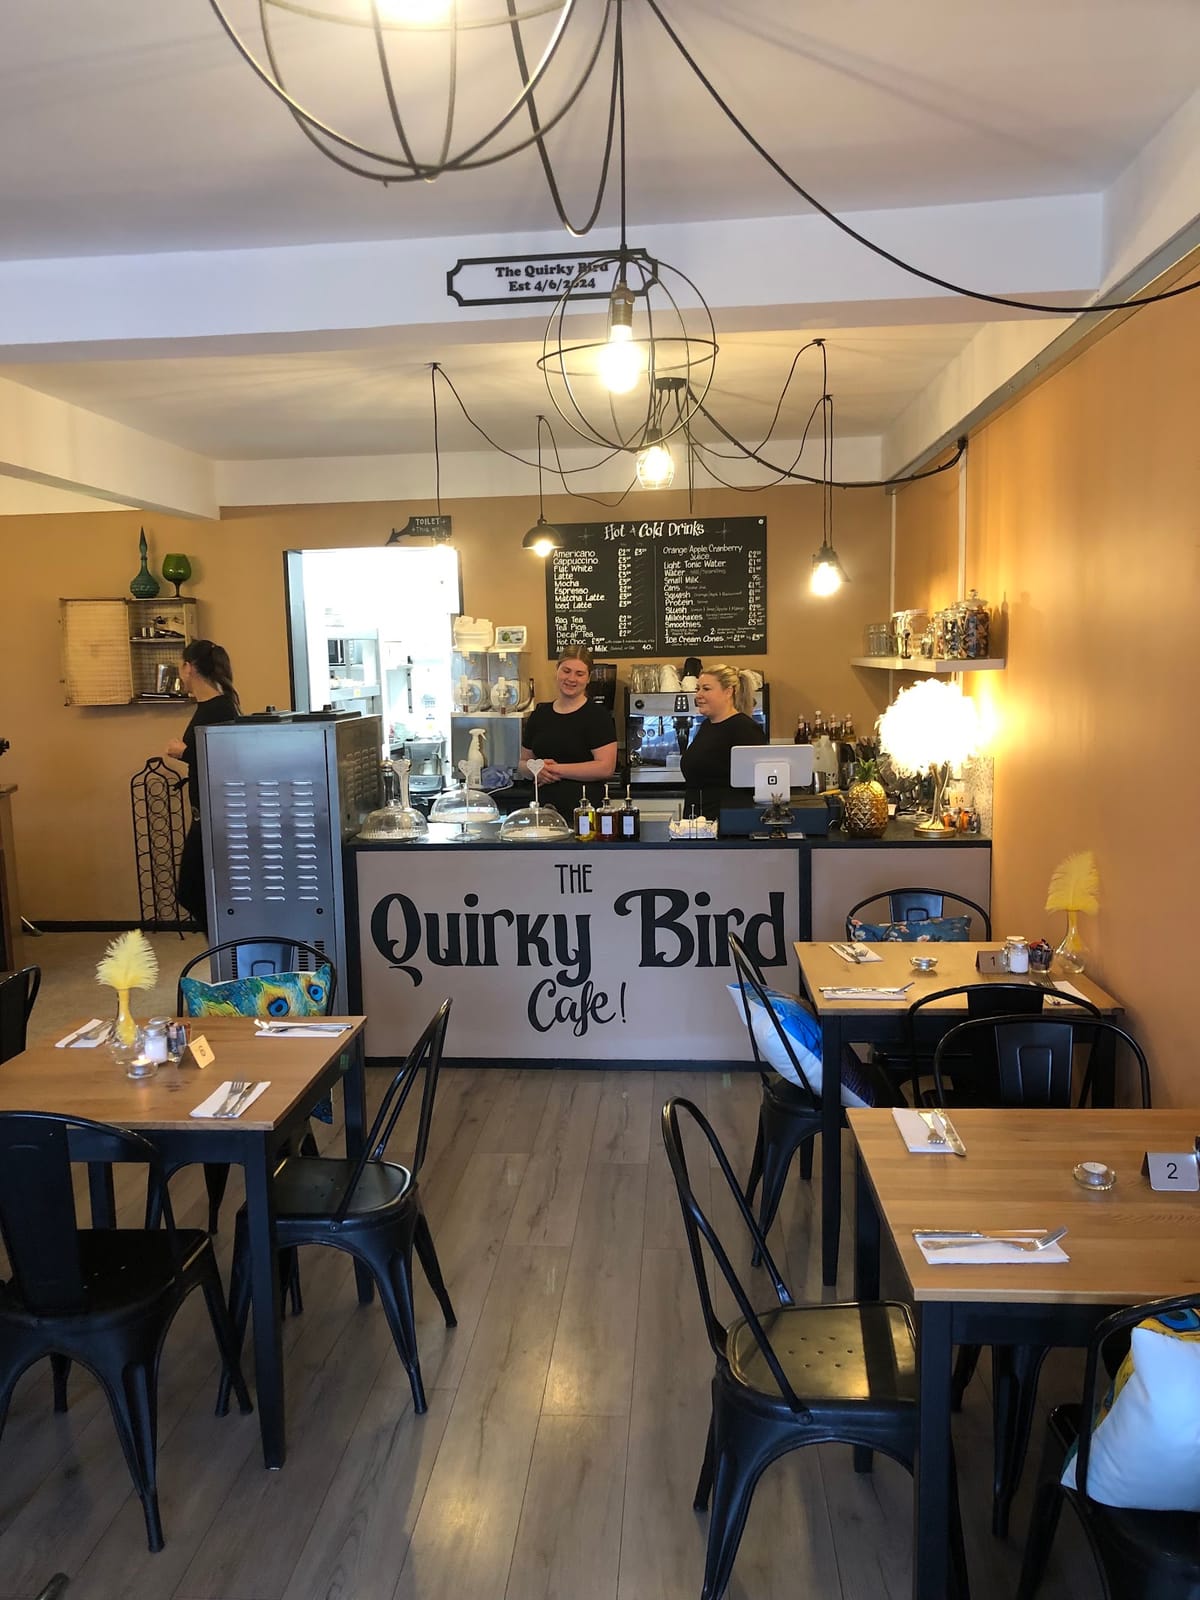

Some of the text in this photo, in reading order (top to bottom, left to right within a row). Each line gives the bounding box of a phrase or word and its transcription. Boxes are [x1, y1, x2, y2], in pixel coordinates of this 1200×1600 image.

[495, 261, 609, 278] The Quirky Bird
[508, 281, 531, 292] Est
[415, 517, 441, 526] TOILET
[604, 523, 626, 540] Hot
[638, 522, 665, 539] Cold
[668, 520, 705, 537] Drinks
[552, 549, 596, 558] Americano
[662, 543, 743, 556] Orange Apple Cranberry
[553, 557, 599, 566] Cappuccino
[663, 560, 681, 570] Light
[684, 559, 702, 569] Tonic
[704, 559, 727, 568] Water
[553, 565, 569, 573] Flat
[571, 564, 593, 573] White
[664, 568, 686, 577] Water
[553, 572, 574, 581] Latte
[664, 576, 683, 585] Small
[685, 575, 700, 584] Milk
[554, 580, 580, 588] Mocha
[663, 584, 681, 593] Cans
[554, 587, 589, 596] Espresso
[664, 591, 691, 600] Squash
[554, 594, 583, 602] Matcha
[585, 593, 606, 602] Latte
[554, 602, 570, 610] Iced
[573, 601, 593, 609] Latte
[664, 599, 694, 607] Protein
[571, 616, 584, 624] Tea
[665, 613, 704, 622] Milkshakes
[555, 624, 568, 632] Tea
[665, 621, 702, 629] Smoothies
[556, 630, 579, 639] Decaf
[582, 630, 594, 638] Tea
[665, 635, 679, 644] Ice
[679, 635, 702, 644] Cream
[703, 634, 724, 643] Cones
[569, 638, 587, 646] Choc
[594, 644, 609, 653] Milk
[554, 864, 593, 894] THE
[370, 888, 788, 987] Quirky Bird
[1166, 1162, 1179, 1180] 2
